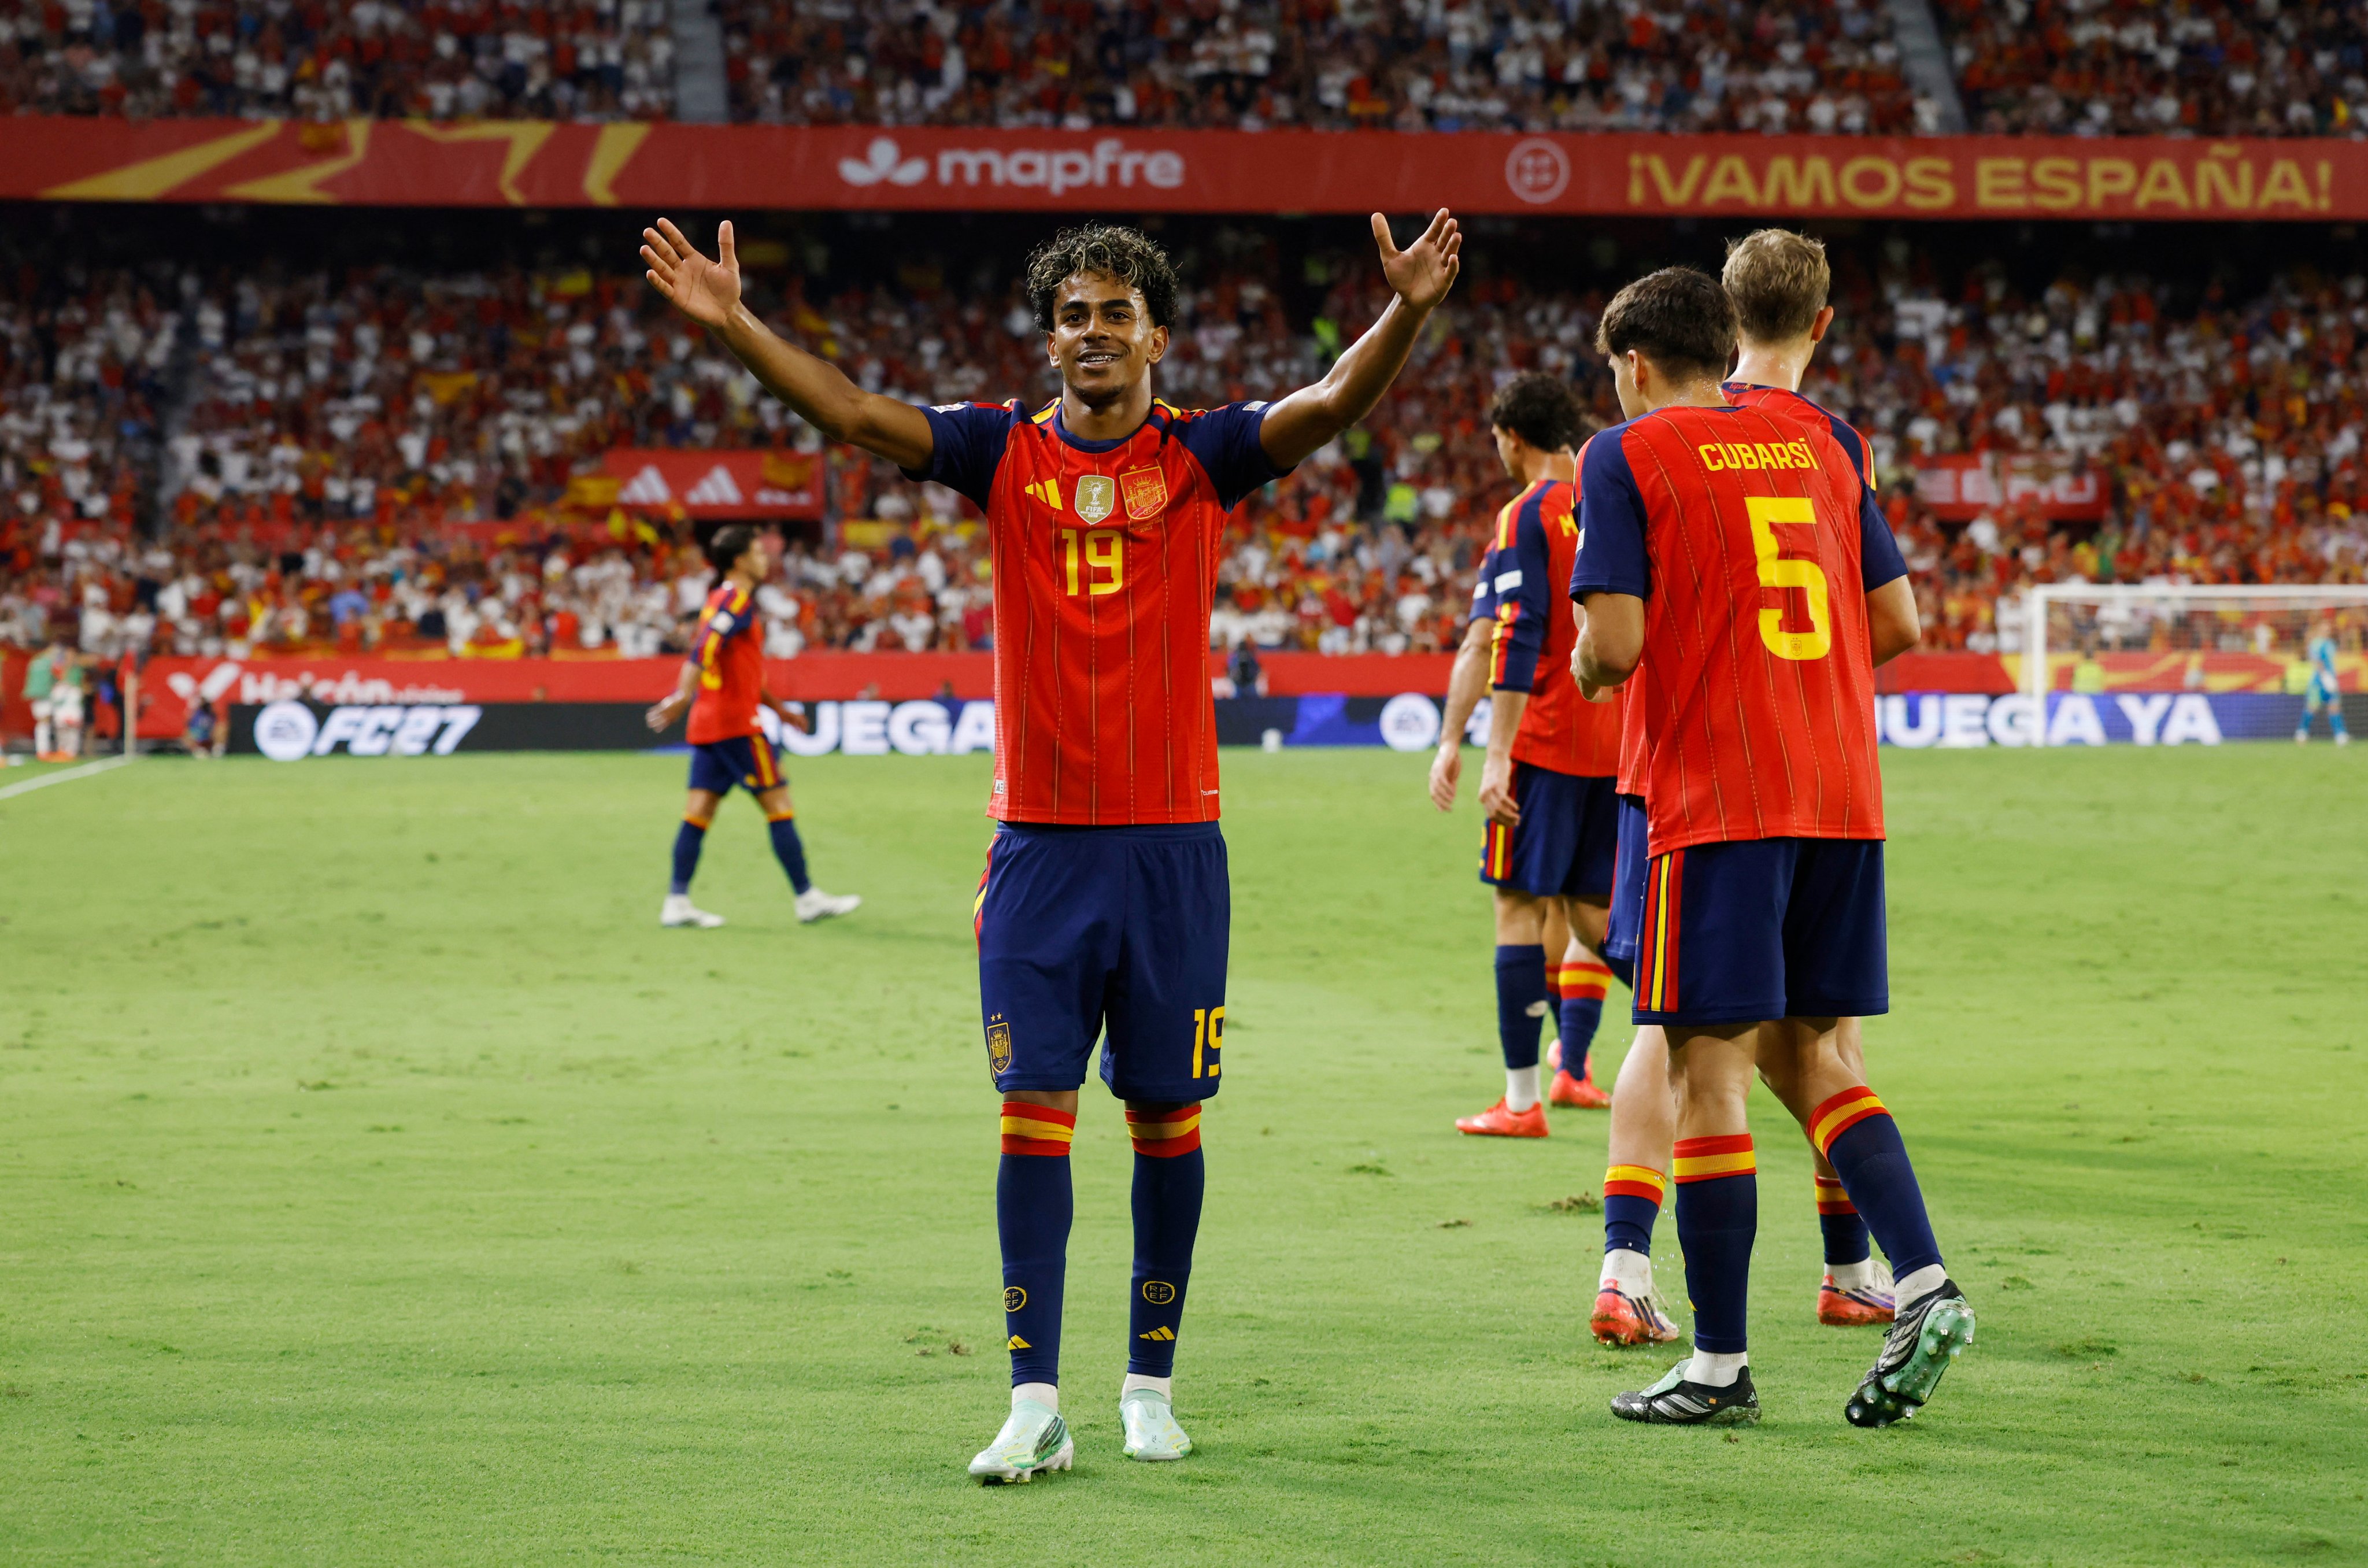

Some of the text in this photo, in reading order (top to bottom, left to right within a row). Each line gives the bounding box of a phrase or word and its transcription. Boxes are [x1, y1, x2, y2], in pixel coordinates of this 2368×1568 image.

[938, 138, 1185, 197] mapfre
[1627, 152, 1957, 209] ¡VAMOS
[1975, 143, 2333, 210] ESPAÑA!
[1699, 438, 1819, 471] CUBARSÍ
[1061, 528, 1123, 596] 19
[1744, 497, 1832, 660] 5
[1875, 693, 2225, 747] UEGA YA
[1192, 1006, 1224, 1079] 19
